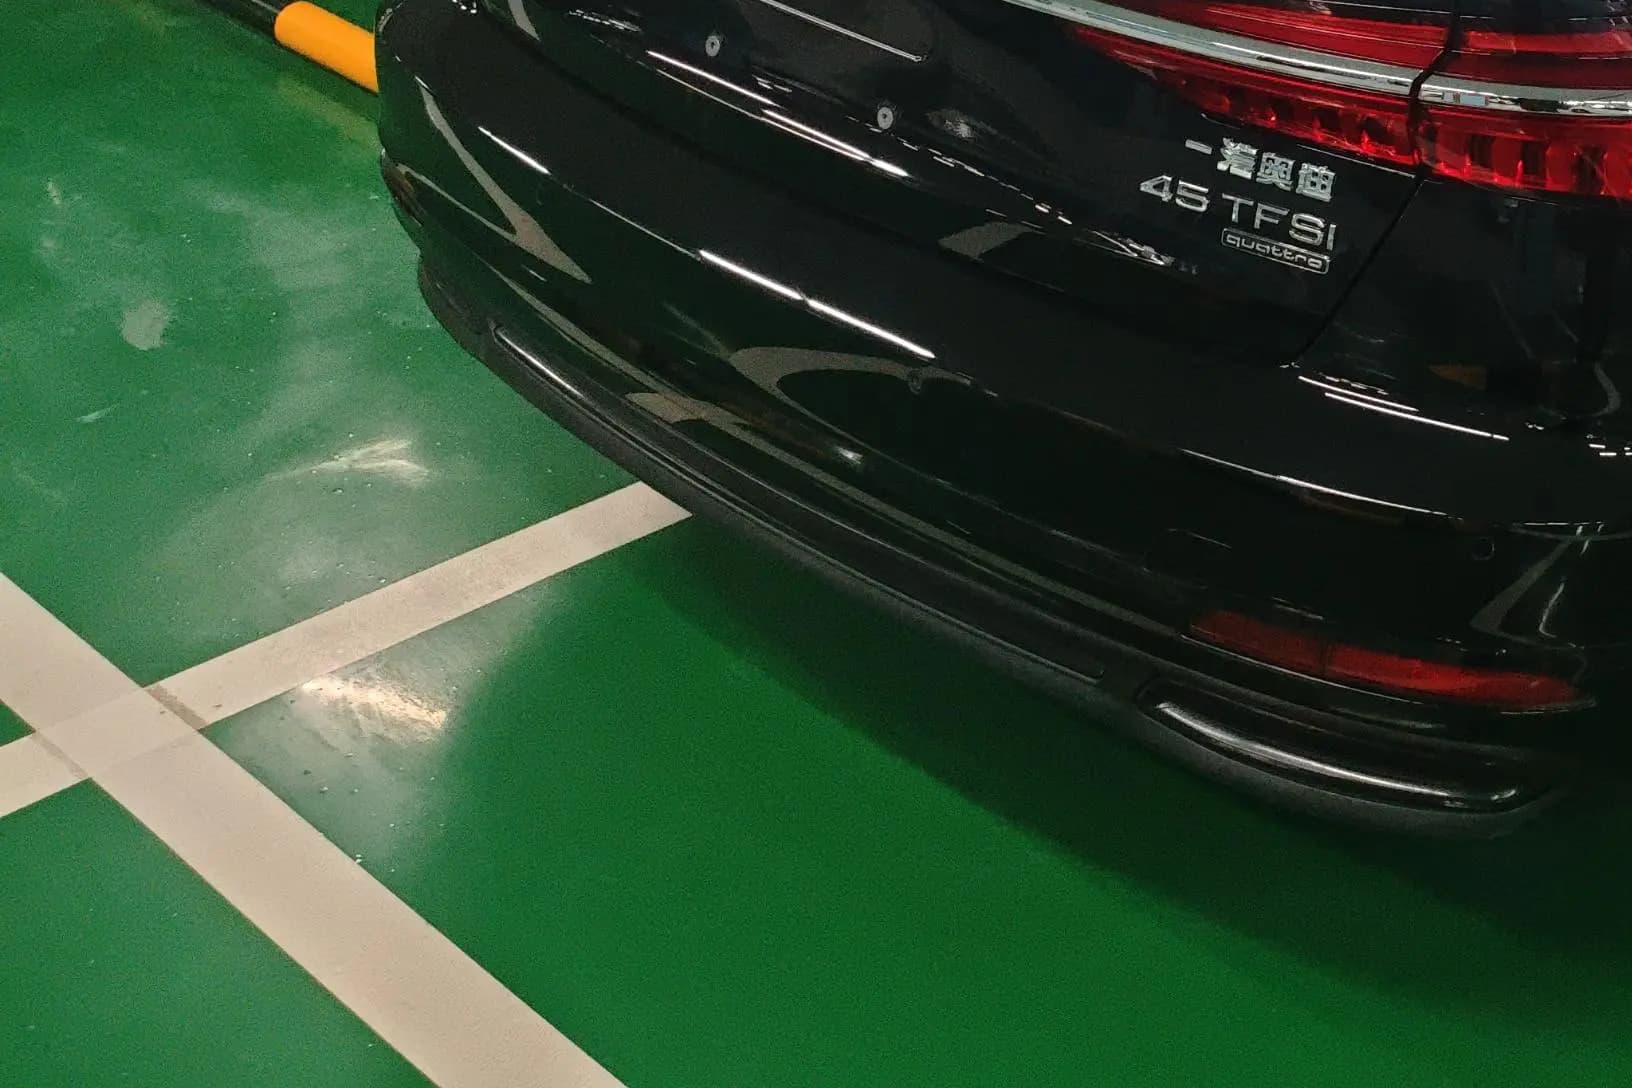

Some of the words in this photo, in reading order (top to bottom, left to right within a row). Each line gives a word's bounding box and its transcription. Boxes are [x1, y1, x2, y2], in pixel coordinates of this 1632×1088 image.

[1140, 174, 1211, 213] 45
[1221, 192, 1337, 251] TFSI
[1226, 232, 1324, 269] quattro
